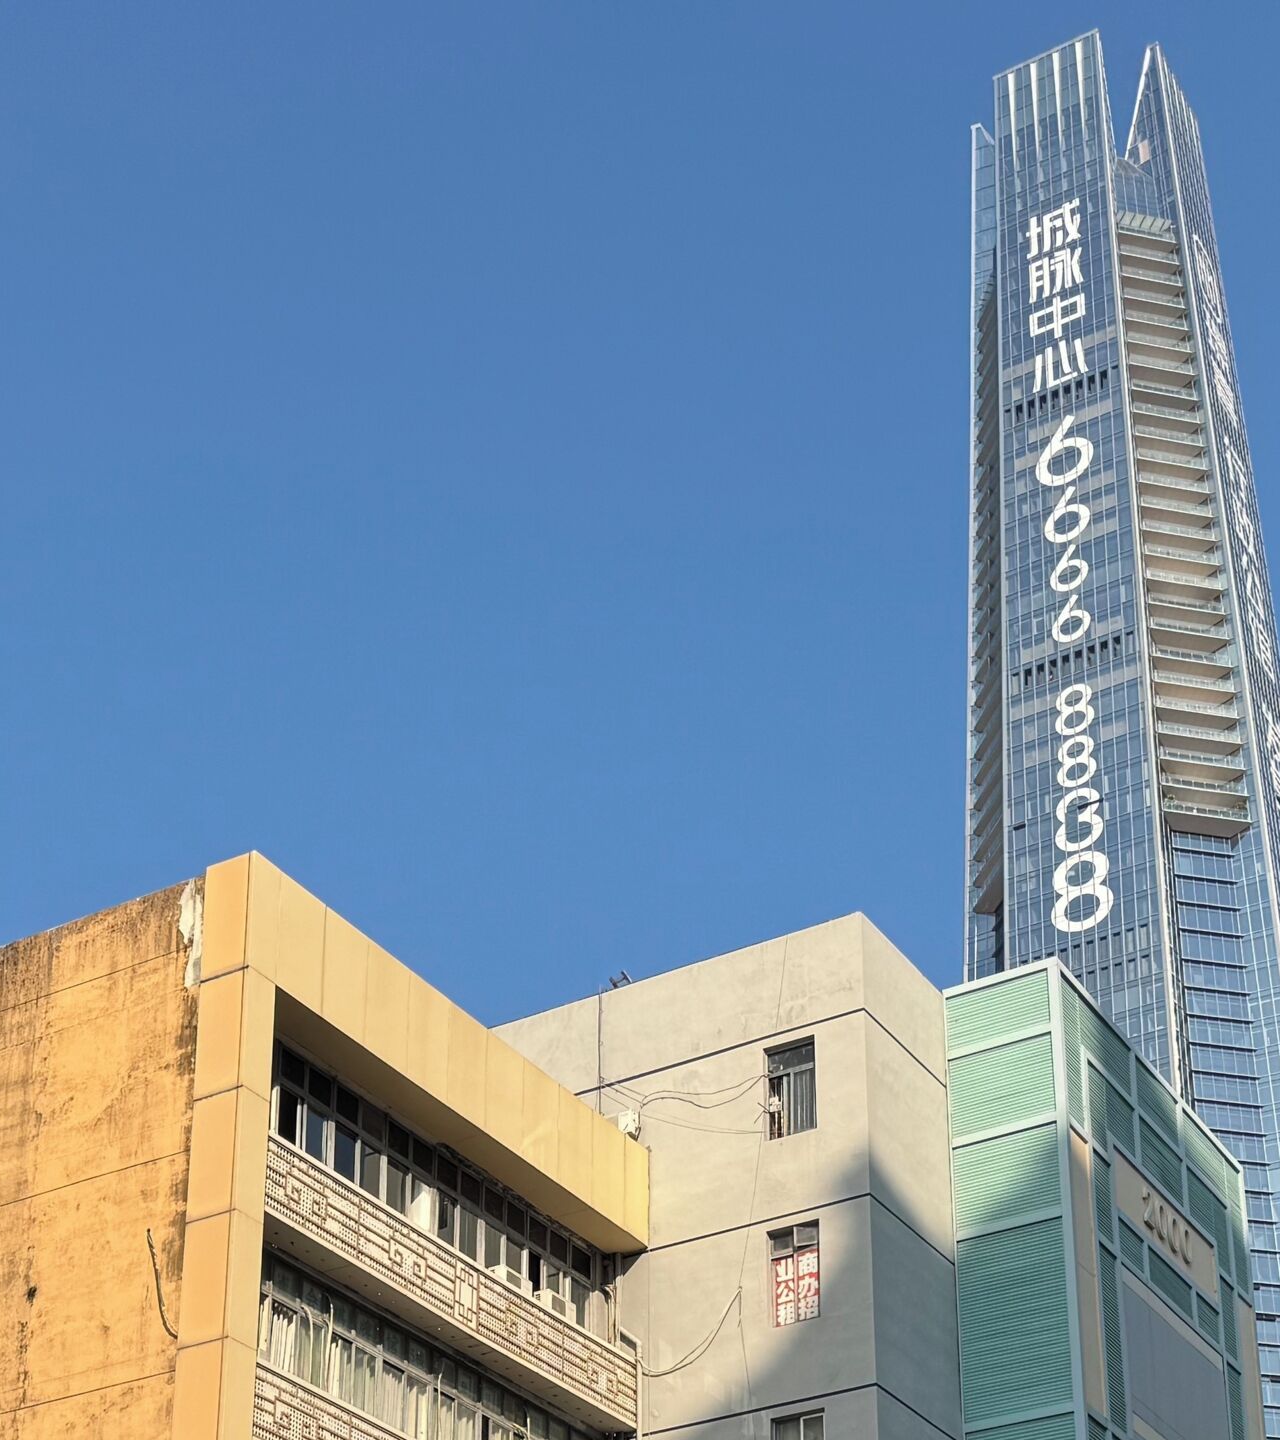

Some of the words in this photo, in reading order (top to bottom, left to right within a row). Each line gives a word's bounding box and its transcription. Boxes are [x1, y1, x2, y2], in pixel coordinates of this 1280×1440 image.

[1025, 198, 1088, 393] 城脉中心
[1035, 414, 1094, 643] 6666
[1142, 1187, 1192, 1266] 2000
